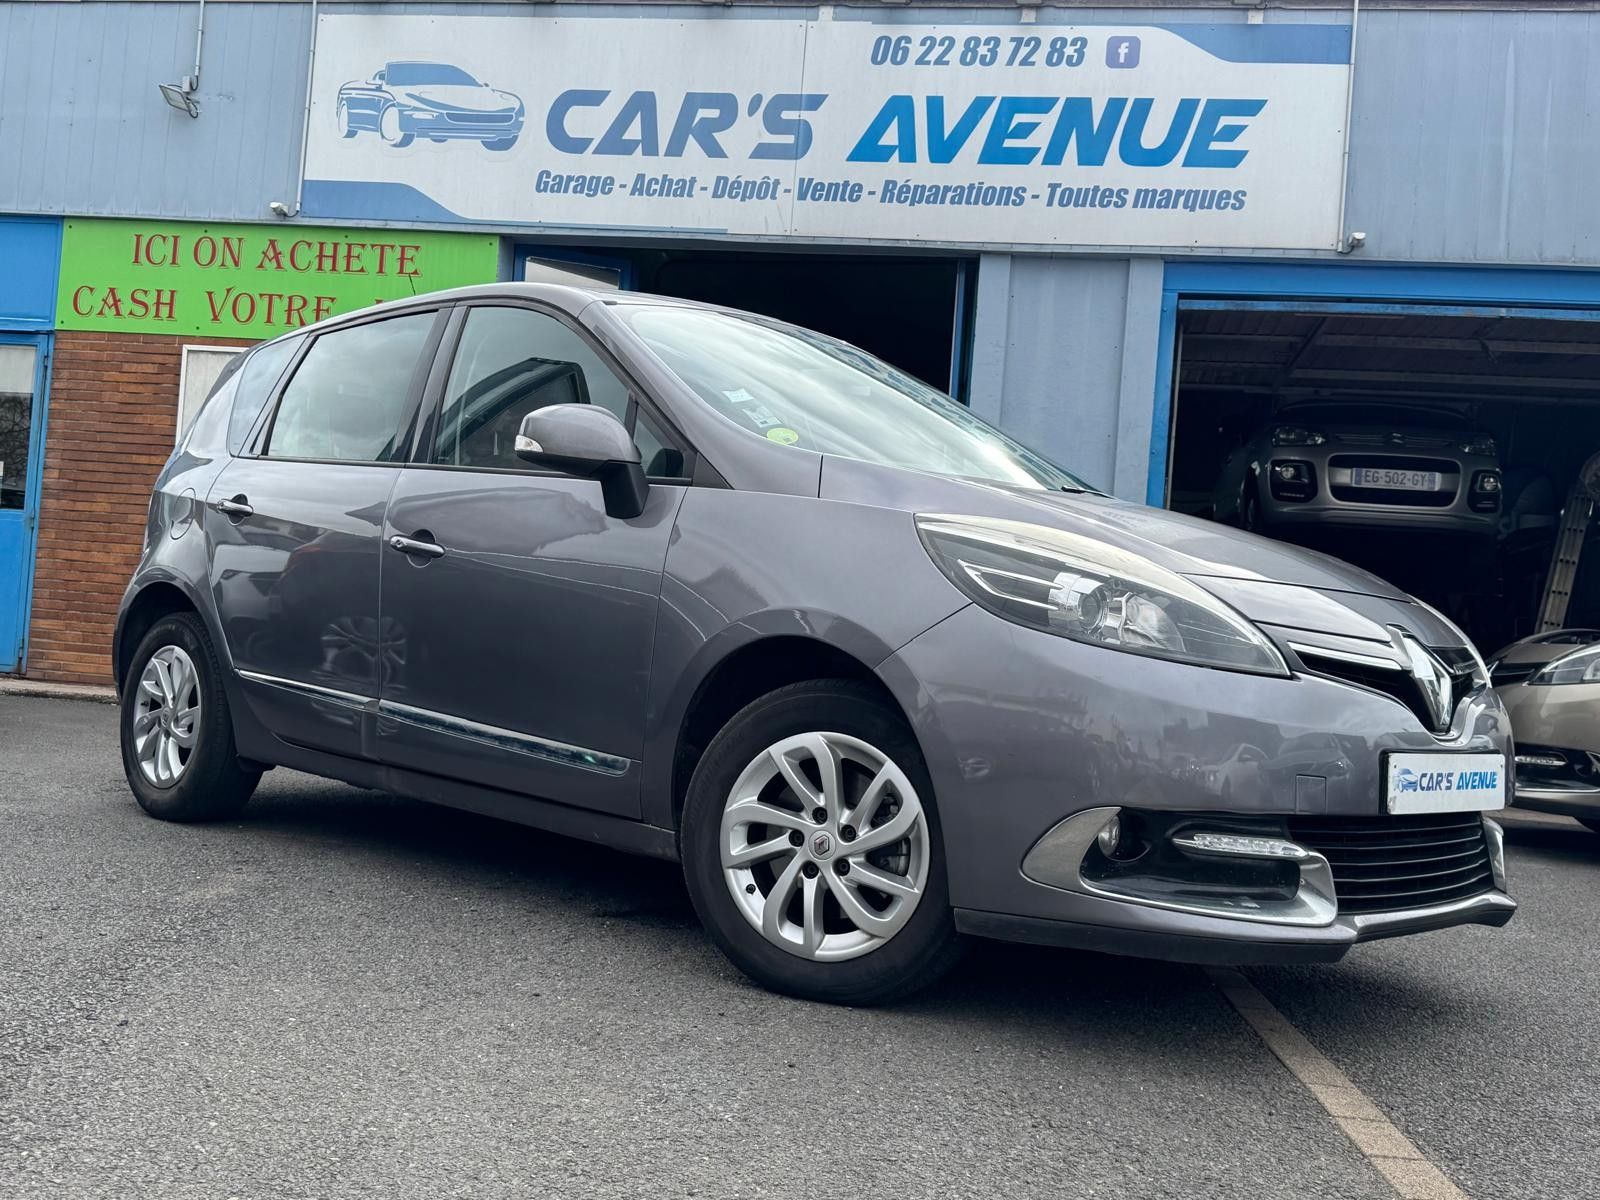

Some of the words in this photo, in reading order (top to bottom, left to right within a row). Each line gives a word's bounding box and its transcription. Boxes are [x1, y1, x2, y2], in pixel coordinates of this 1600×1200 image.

[871, 35, 912, 66] 06
[915, 35, 956, 66] 22
[959, 36, 1001, 67] 83
[1005, 36, 1042, 67] 72
[1045, 36, 1088, 68] 83
[545, 89, 829, 160] CAR'S
[845, 95, 1268, 168] AVENUE
[535, 169, 615, 198] Garage
[629, 173, 698, 198] Achat
[711, 175, 782, 202] Dépôt
[797, 177, 864, 203] Vente
[879, 179, 1027, 207] Réparations
[1046, 182, 1129, 209] Toutes
[1132, 187, 1248, 212] marques
[131, 233, 180, 267] ICI
[193, 235, 244, 269] ON
[256, 239, 422, 277] ACHETE
[72, 285, 178, 321] CASH
[205, 285, 337, 328] VOTRE
[1419, 772, 1454, 792] CAR'S
[1456, 771, 1498, 790] AVENUE
